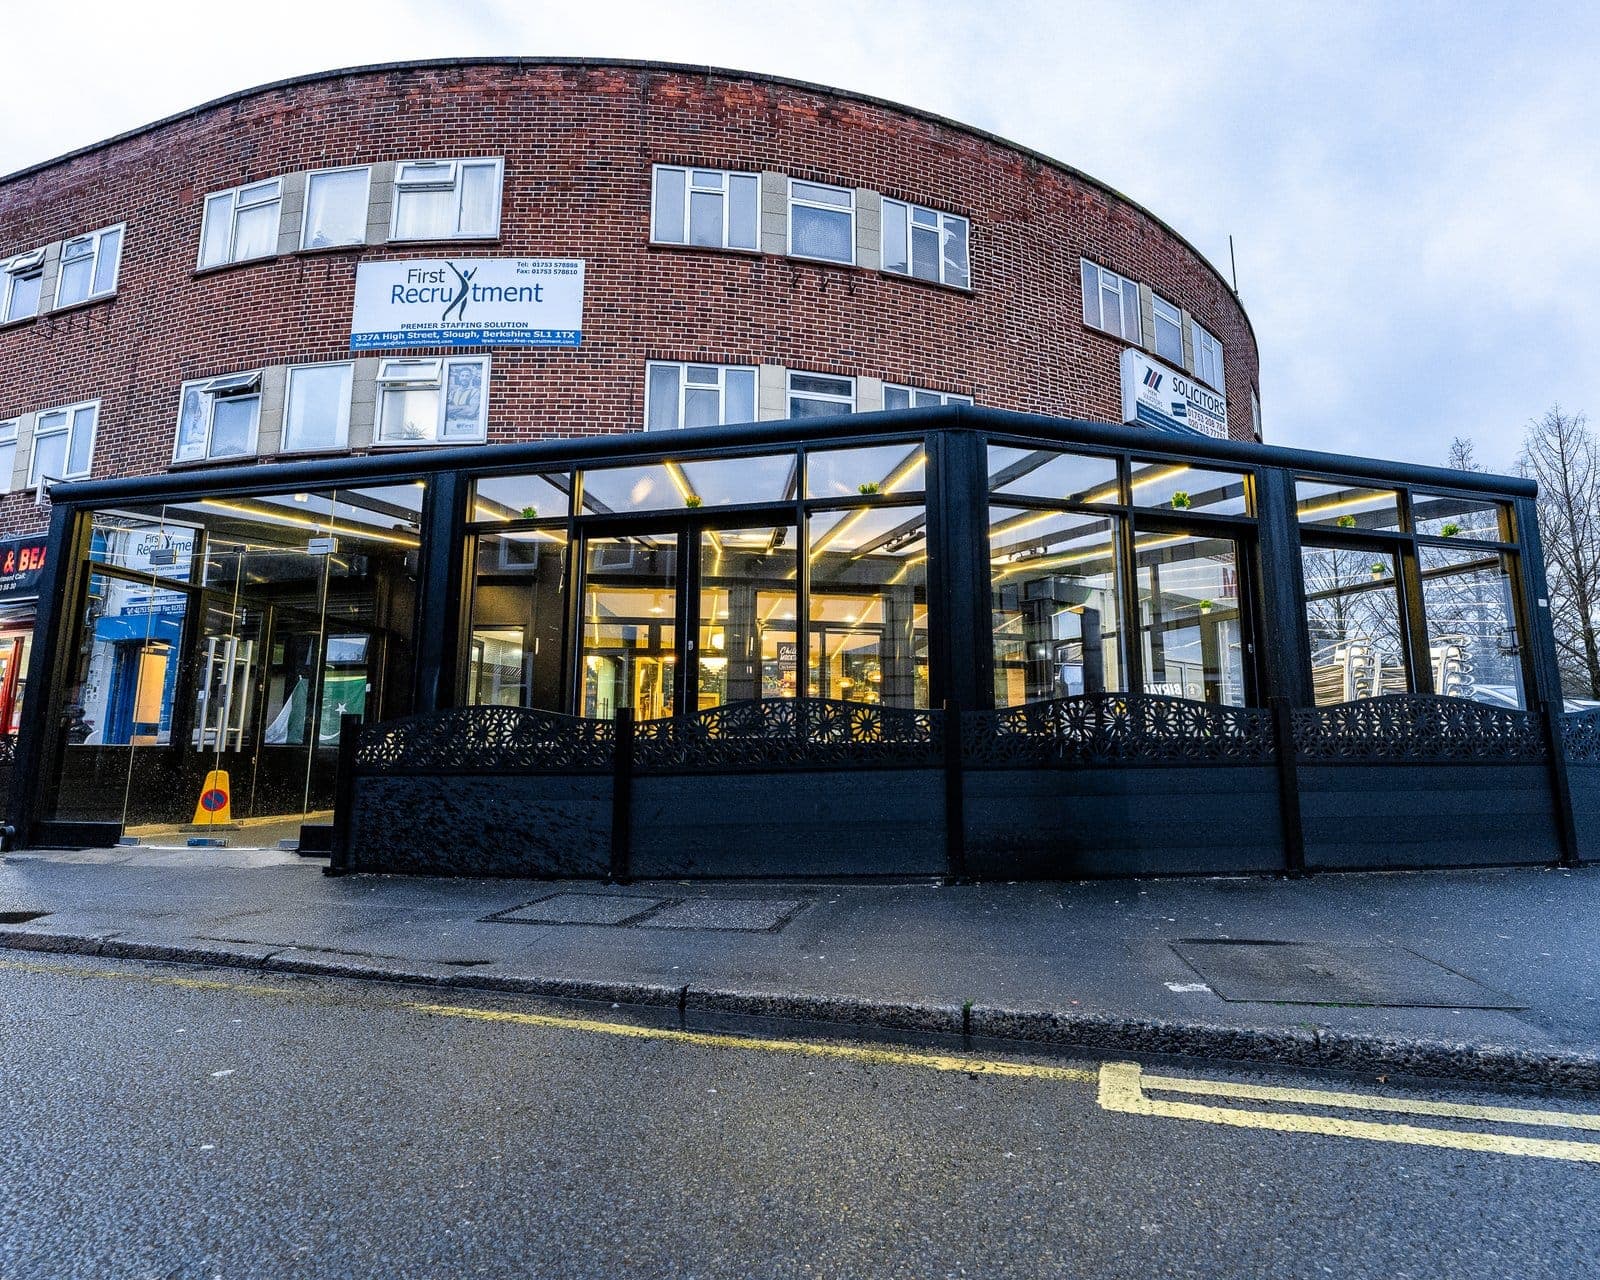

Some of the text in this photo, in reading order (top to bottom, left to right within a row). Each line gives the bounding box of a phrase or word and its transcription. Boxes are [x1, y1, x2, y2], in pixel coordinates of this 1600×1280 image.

[408, 268, 446, 284] First
[383, 332, 405, 341] High
[407, 332, 440, 340] Street,
[442, 331, 480, 340] Slough,
[1172, 377, 1225, 416] SOLICITORS
[145, 534, 159, 543] Firs
[4, 550, 14, 574] &
